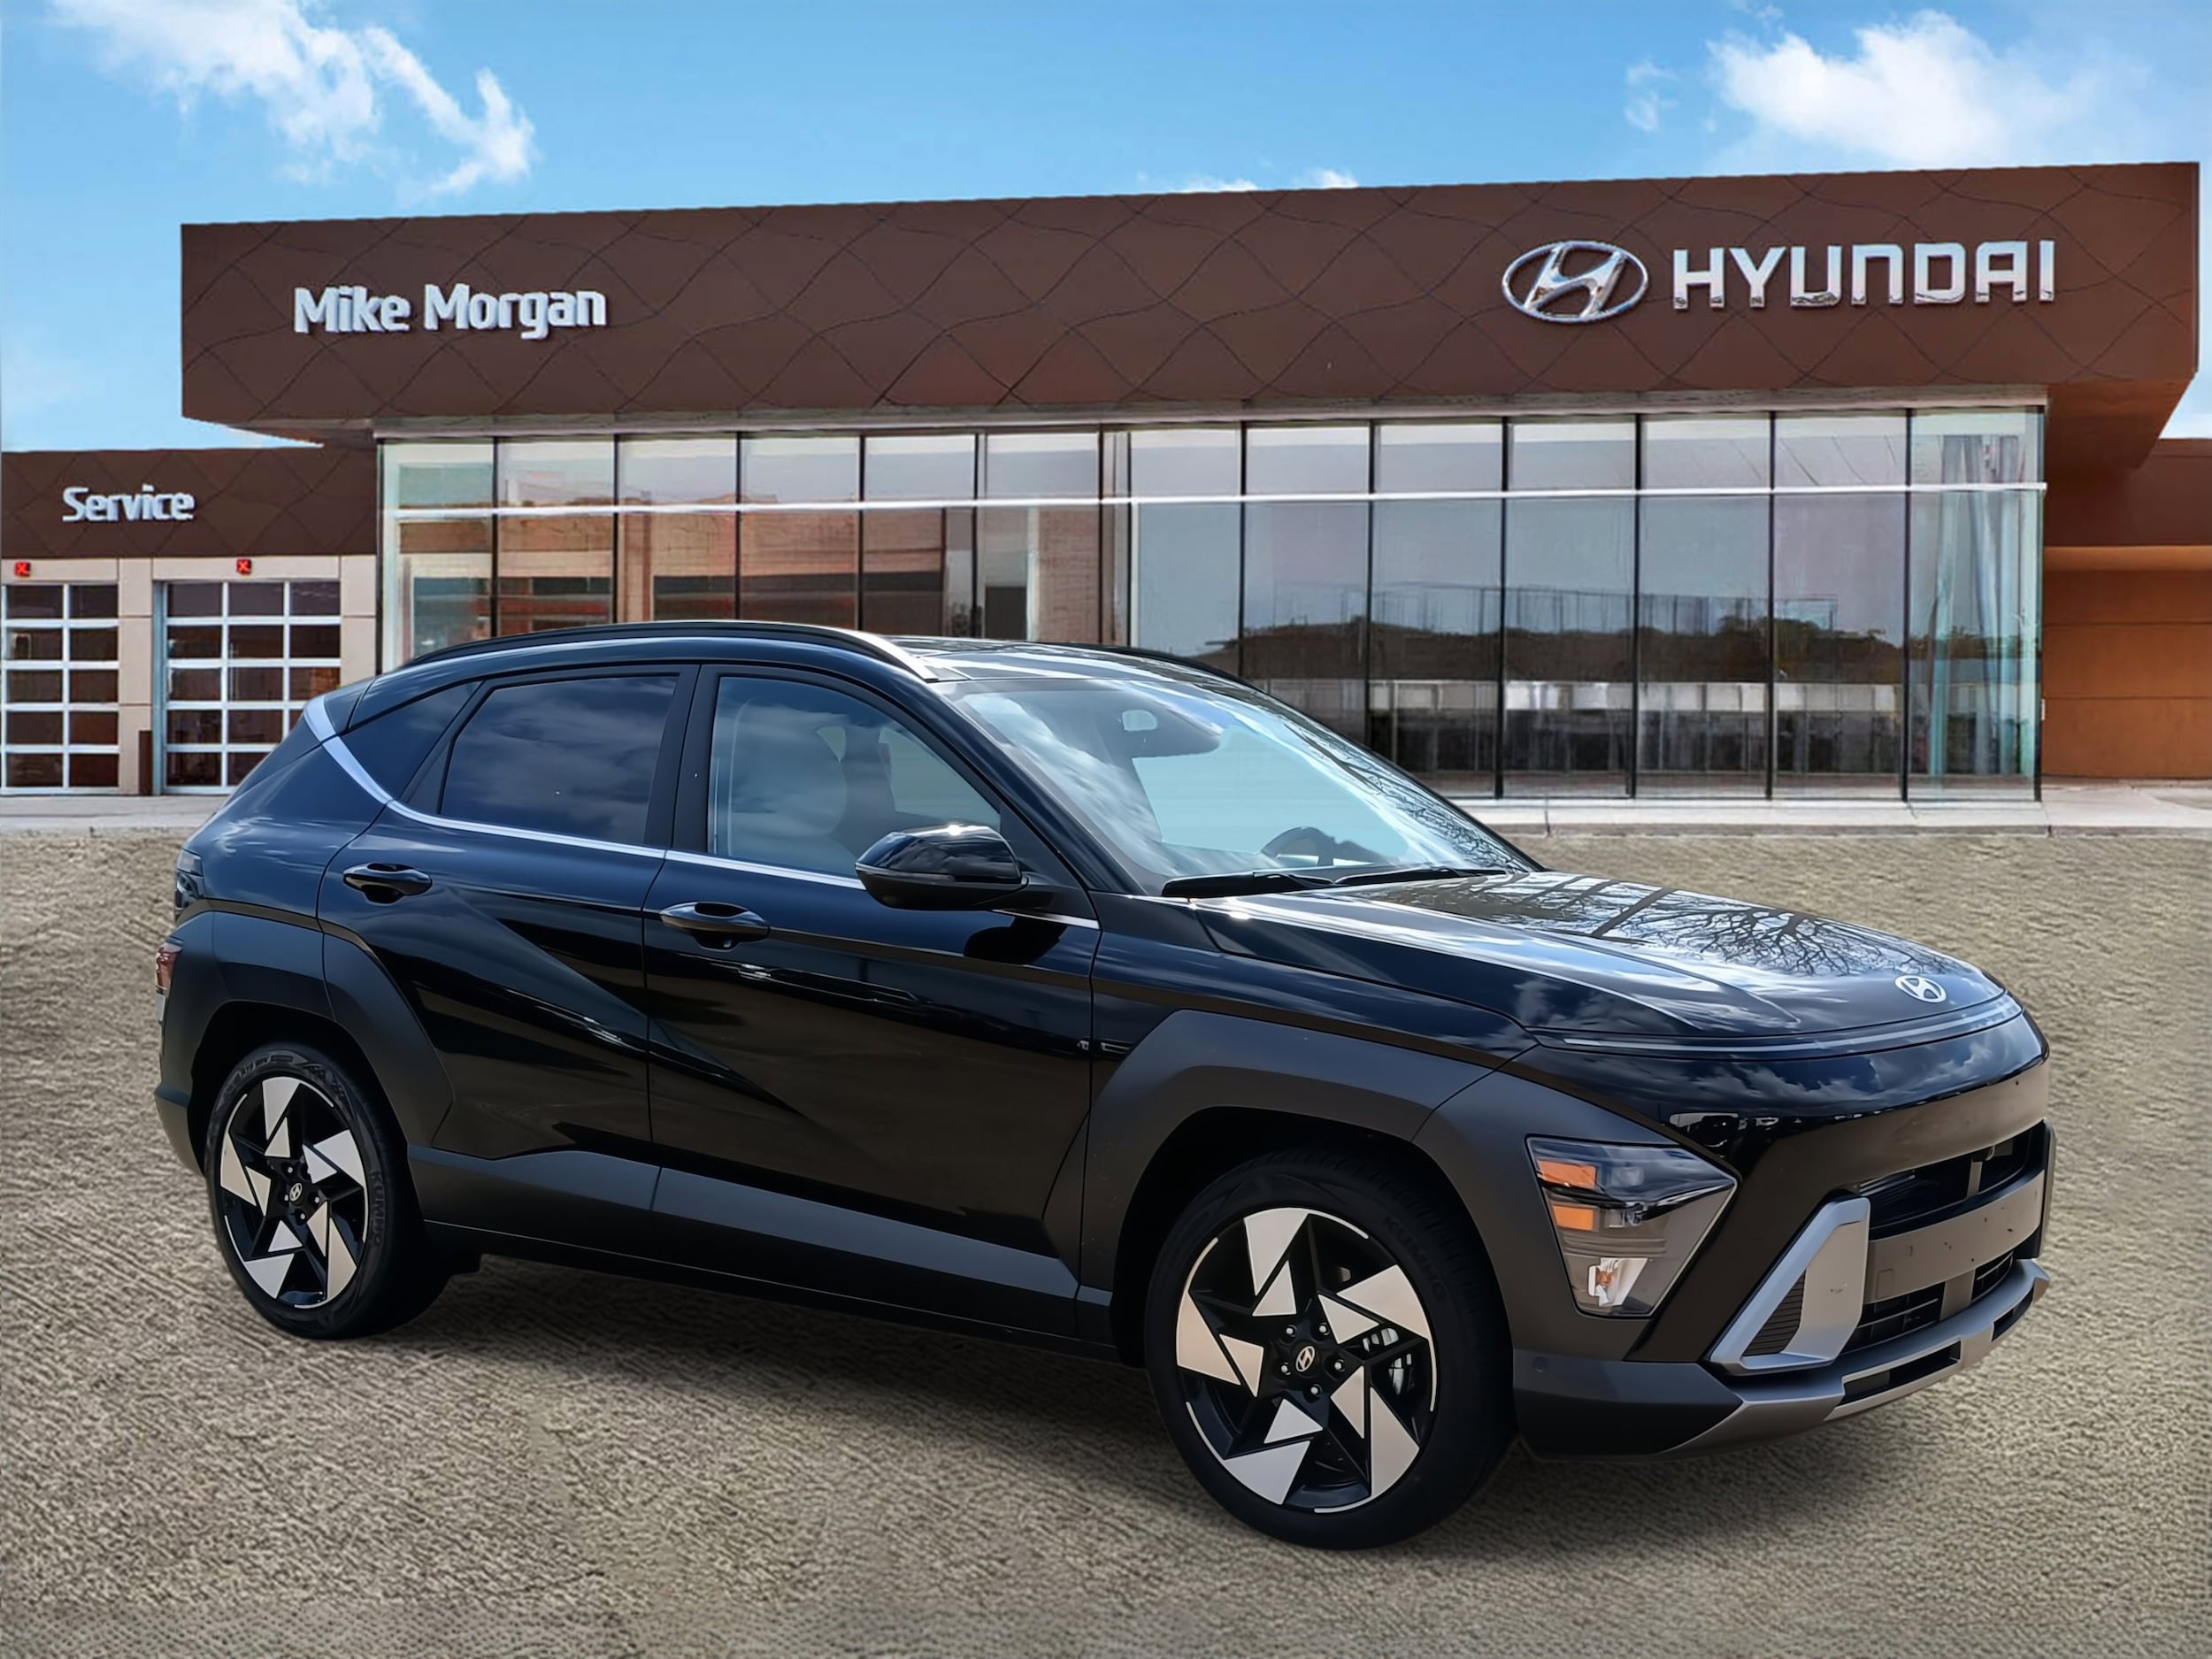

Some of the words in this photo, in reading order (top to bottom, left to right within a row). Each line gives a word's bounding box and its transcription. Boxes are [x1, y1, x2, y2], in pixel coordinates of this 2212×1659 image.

[1673, 240, 2055, 310] HYUNDAI
[294, 285, 411, 334] Mike
[424, 282, 607, 340] Morgan
[62, 484, 196, 521] Service
